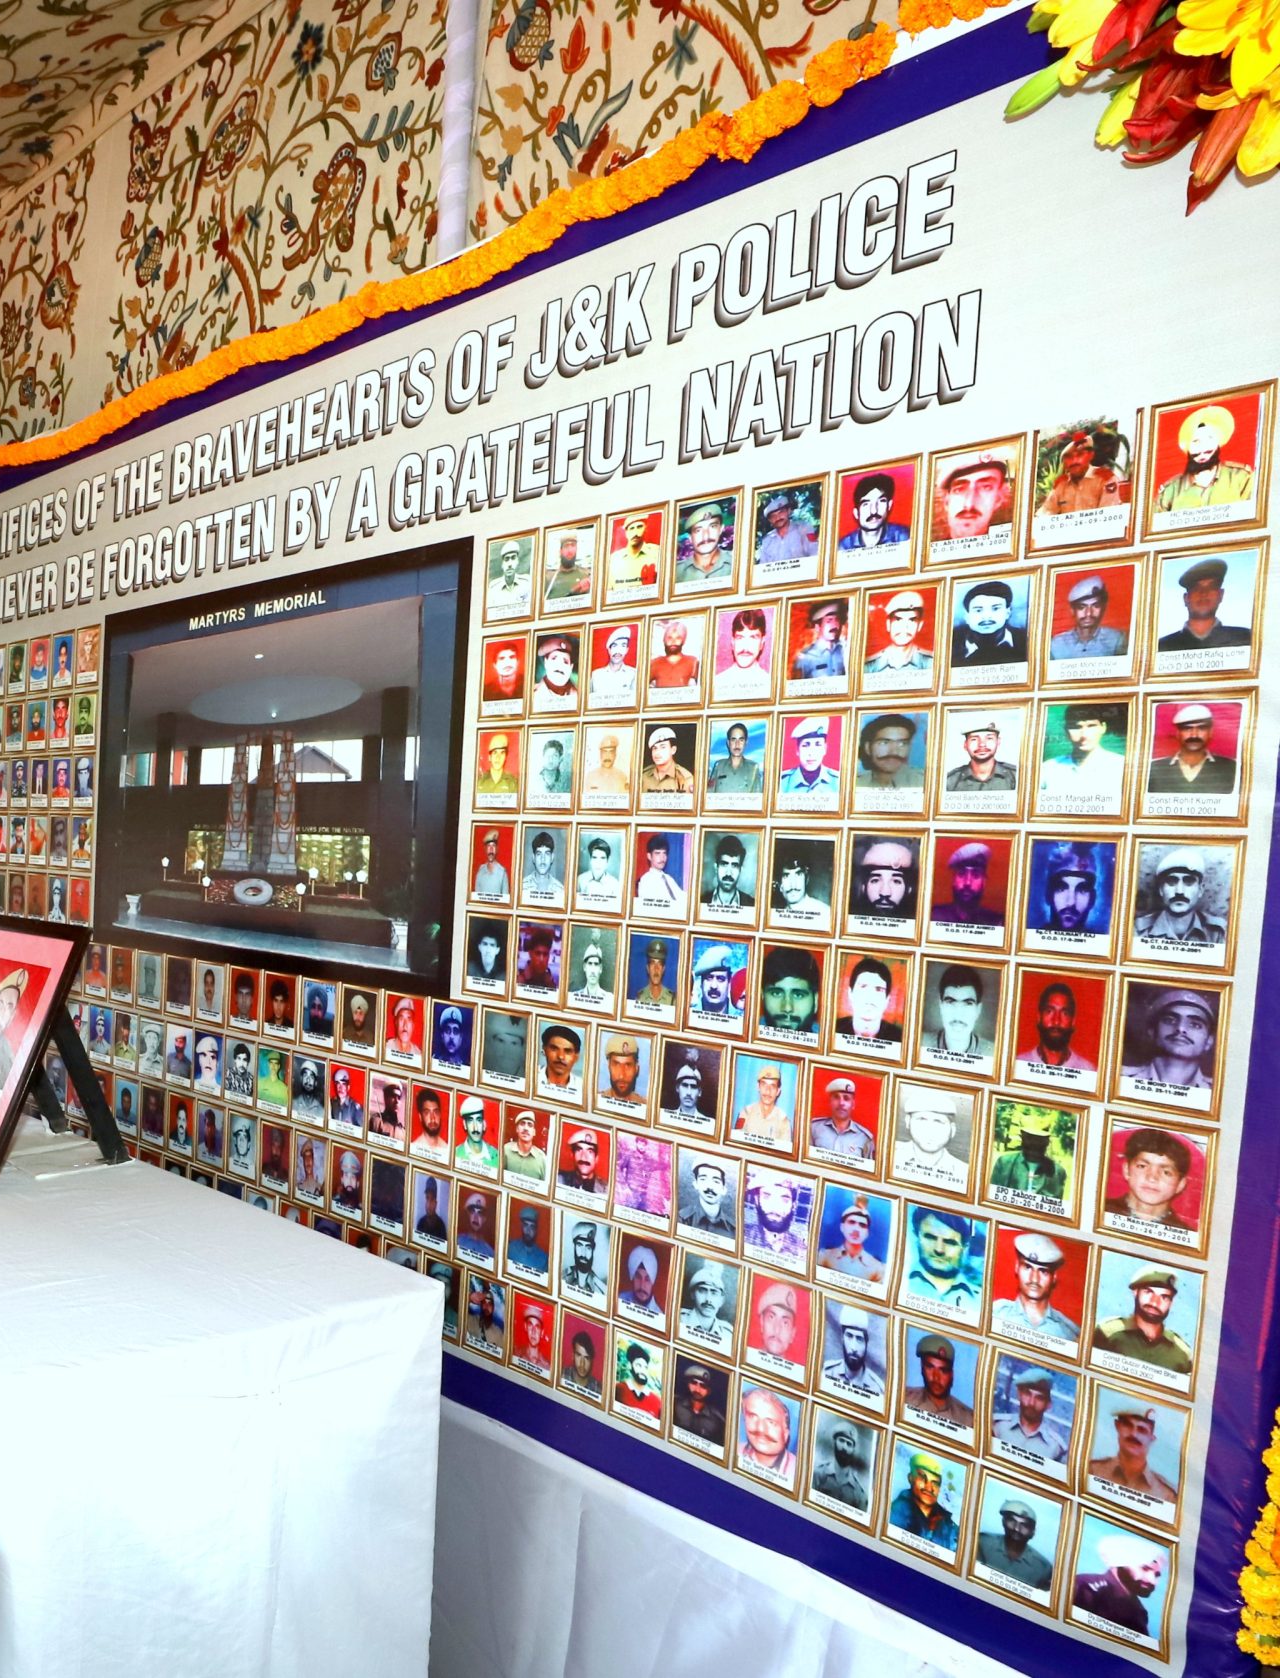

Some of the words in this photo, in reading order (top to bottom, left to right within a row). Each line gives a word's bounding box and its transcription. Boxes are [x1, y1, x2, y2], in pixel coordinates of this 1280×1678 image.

[72, 474, 107, 536] OF
[113, 450, 165, 521] THE
[169, 348, 435, 504] BRAVEHEARTS
[445, 315, 516, 413] OF
[525, 263, 655, 388] J&K
[667, 150, 957, 343] POLICE
[62, 549, 96, 608] BE
[100, 495, 277, 601] FORGOTTEN
[283, 475, 340, 562] BY
[345, 468, 379, 541] A
[392, 386, 664, 532] GRATEFUL
[679, 289, 982, 463] NATION
[189, 608, 246, 631] MARTYRS
[254, 590, 327, 618] MEMORIAL
[1039, 1196, 1063, 1207] Ahmad
